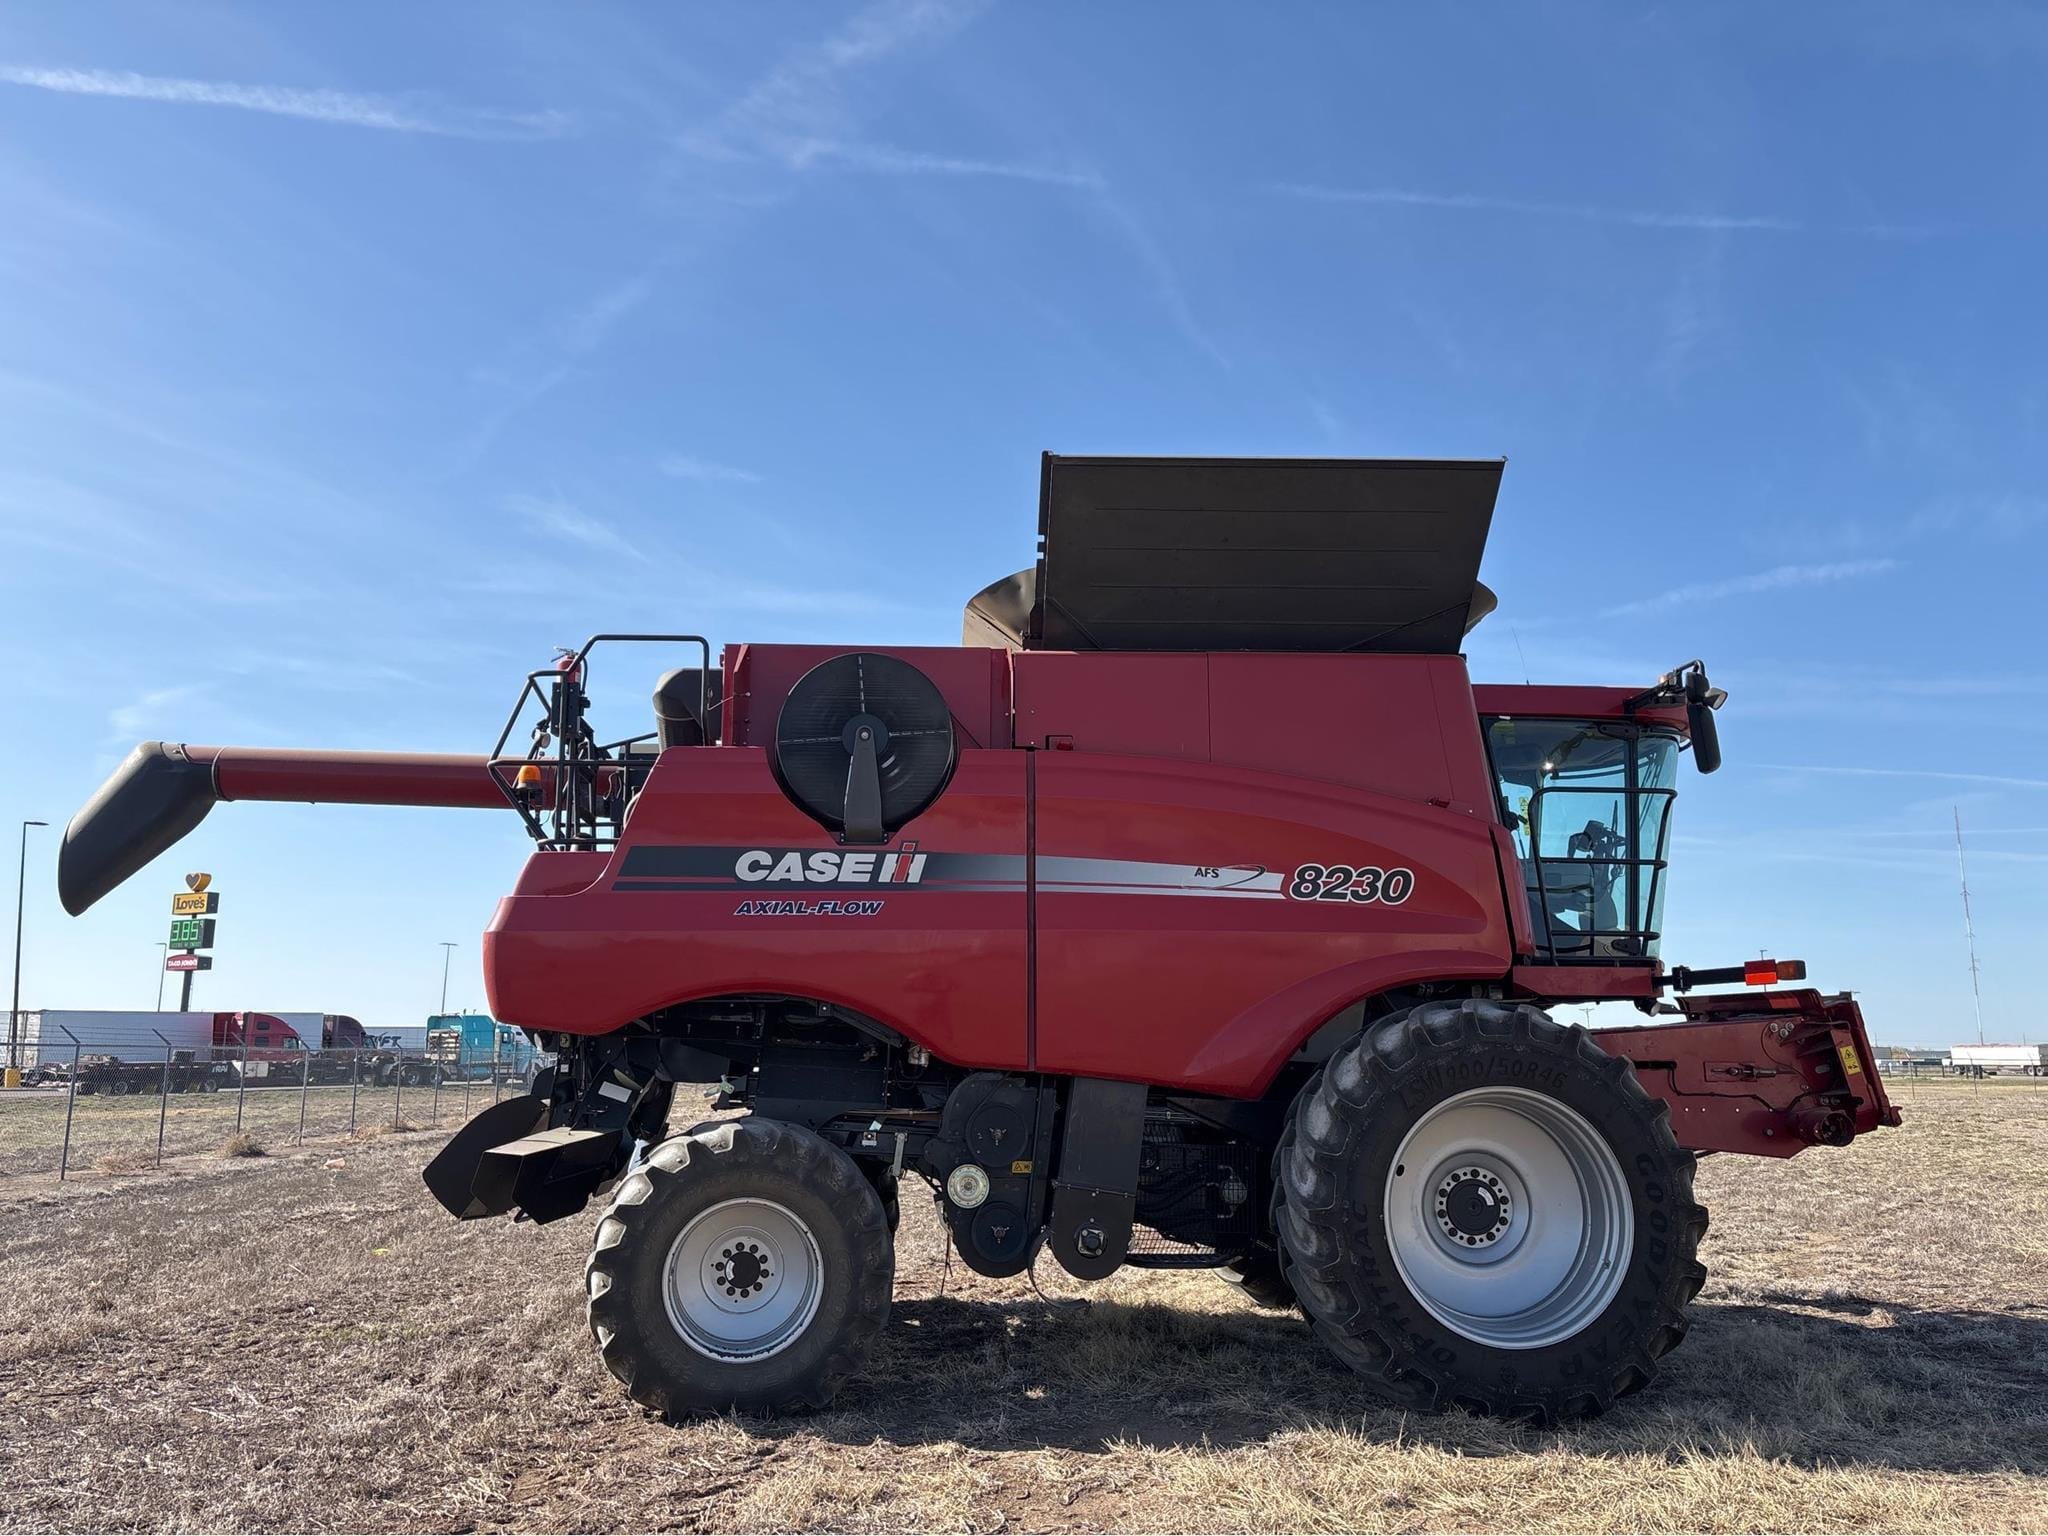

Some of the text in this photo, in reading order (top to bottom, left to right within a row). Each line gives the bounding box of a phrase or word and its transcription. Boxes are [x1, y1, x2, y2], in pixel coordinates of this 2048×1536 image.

[735, 850, 877, 883] CASE
[1194, 867, 1220, 879] AFS
[1289, 863, 1415, 905] 8230
[175, 896, 206, 910] Love's
[733, 901, 885, 916] AXIAL-FLOW
